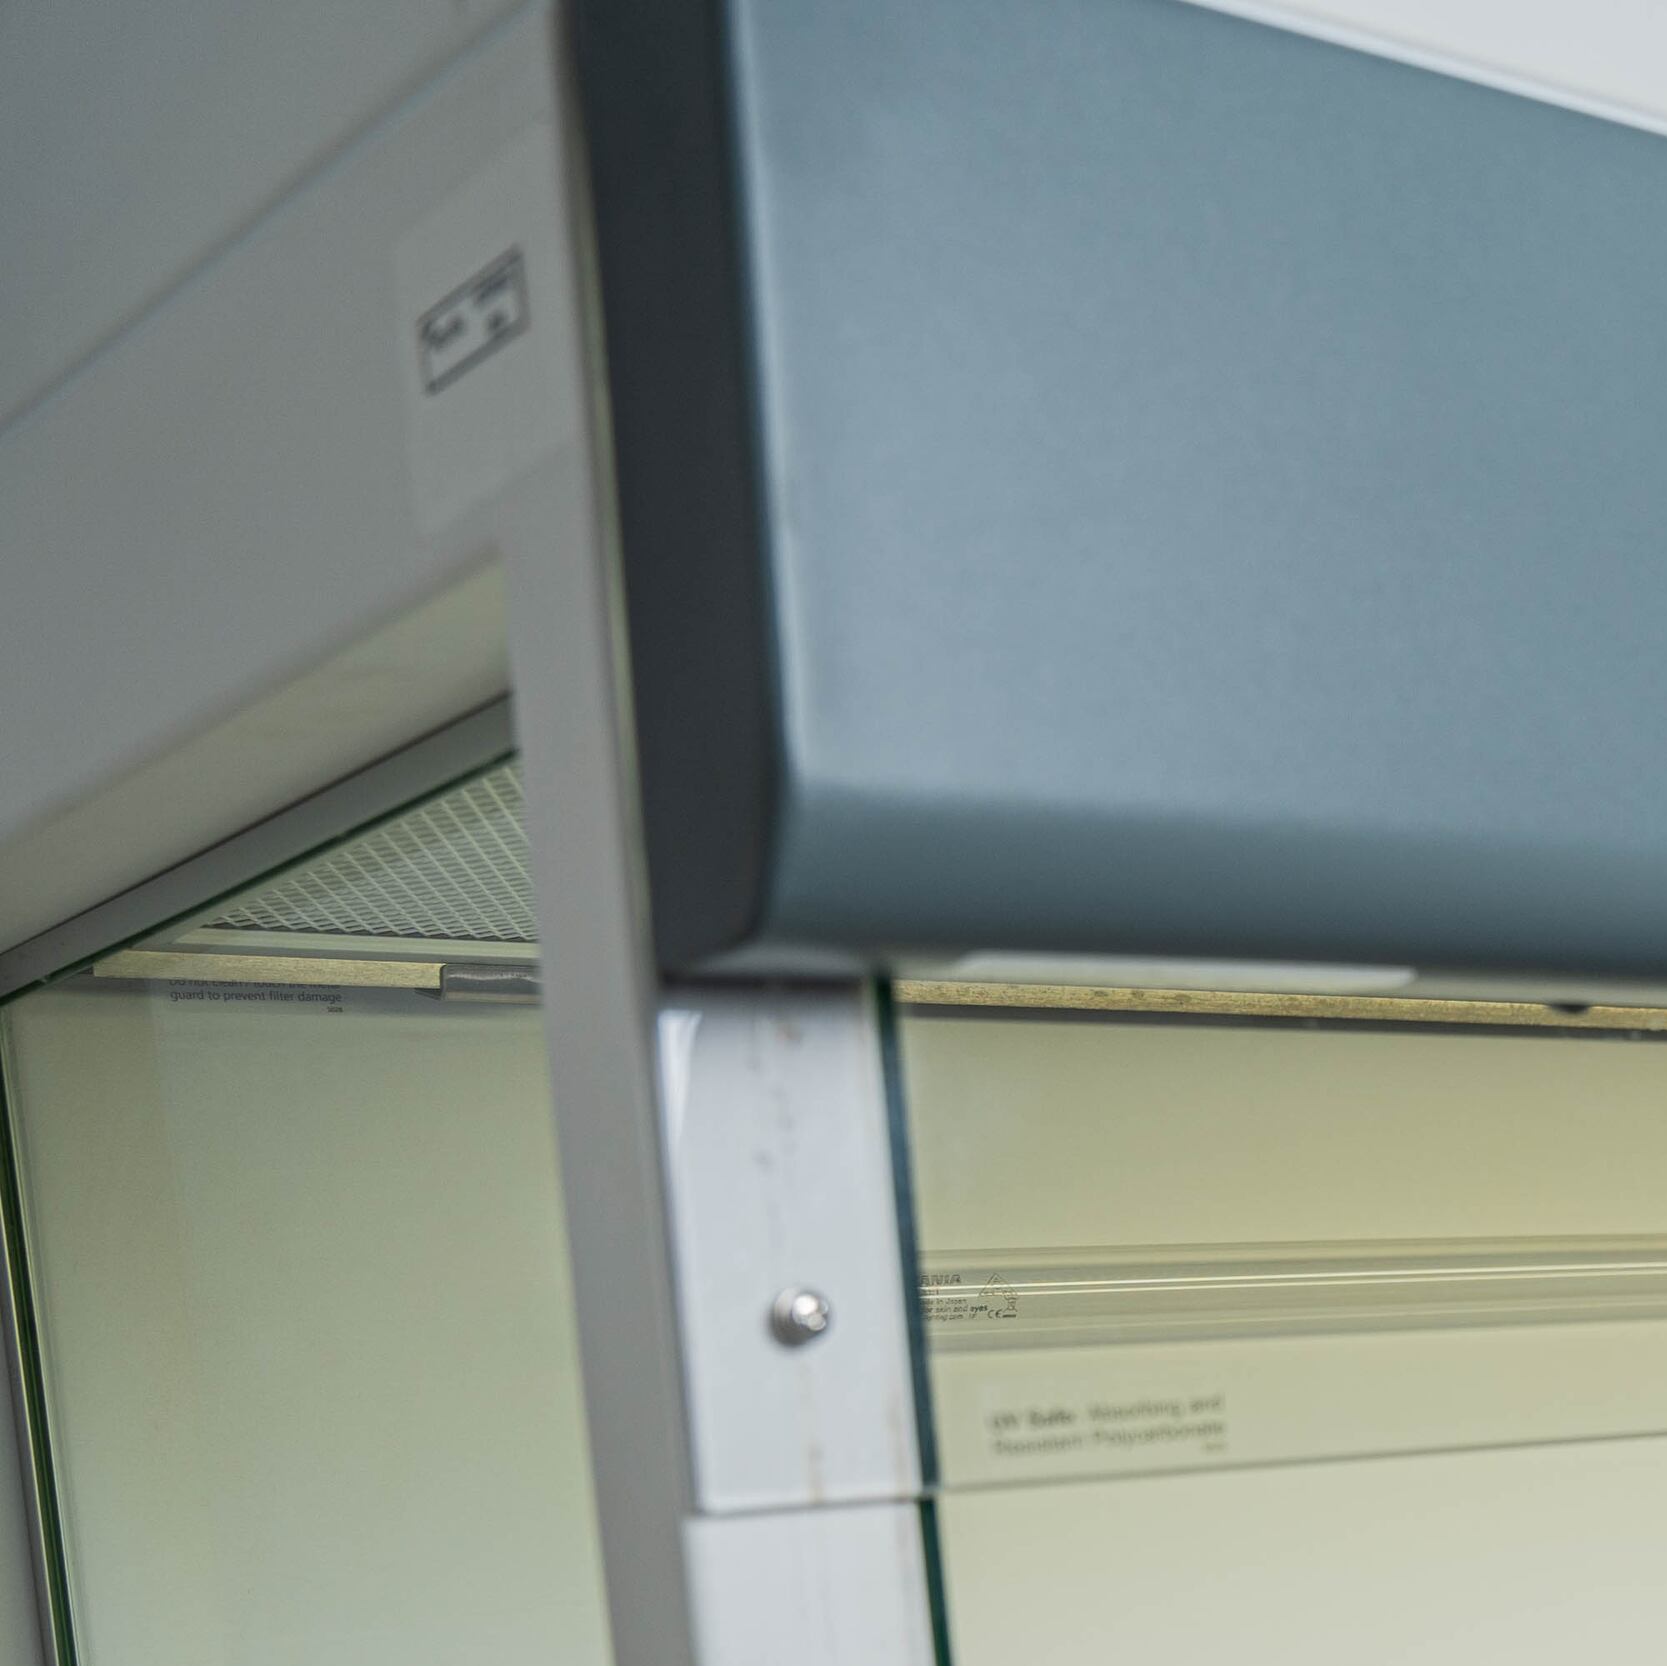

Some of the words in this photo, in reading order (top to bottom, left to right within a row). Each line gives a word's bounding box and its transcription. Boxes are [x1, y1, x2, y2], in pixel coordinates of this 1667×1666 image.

[170, 990, 204, 1002] guard
[208, 991, 221, 1001] to
[224, 991, 265, 1003] prevent
[269, 991, 294, 1002] filter
[298, 992, 342, 1005] damage
[969, 1304, 988, 1314] eyes
